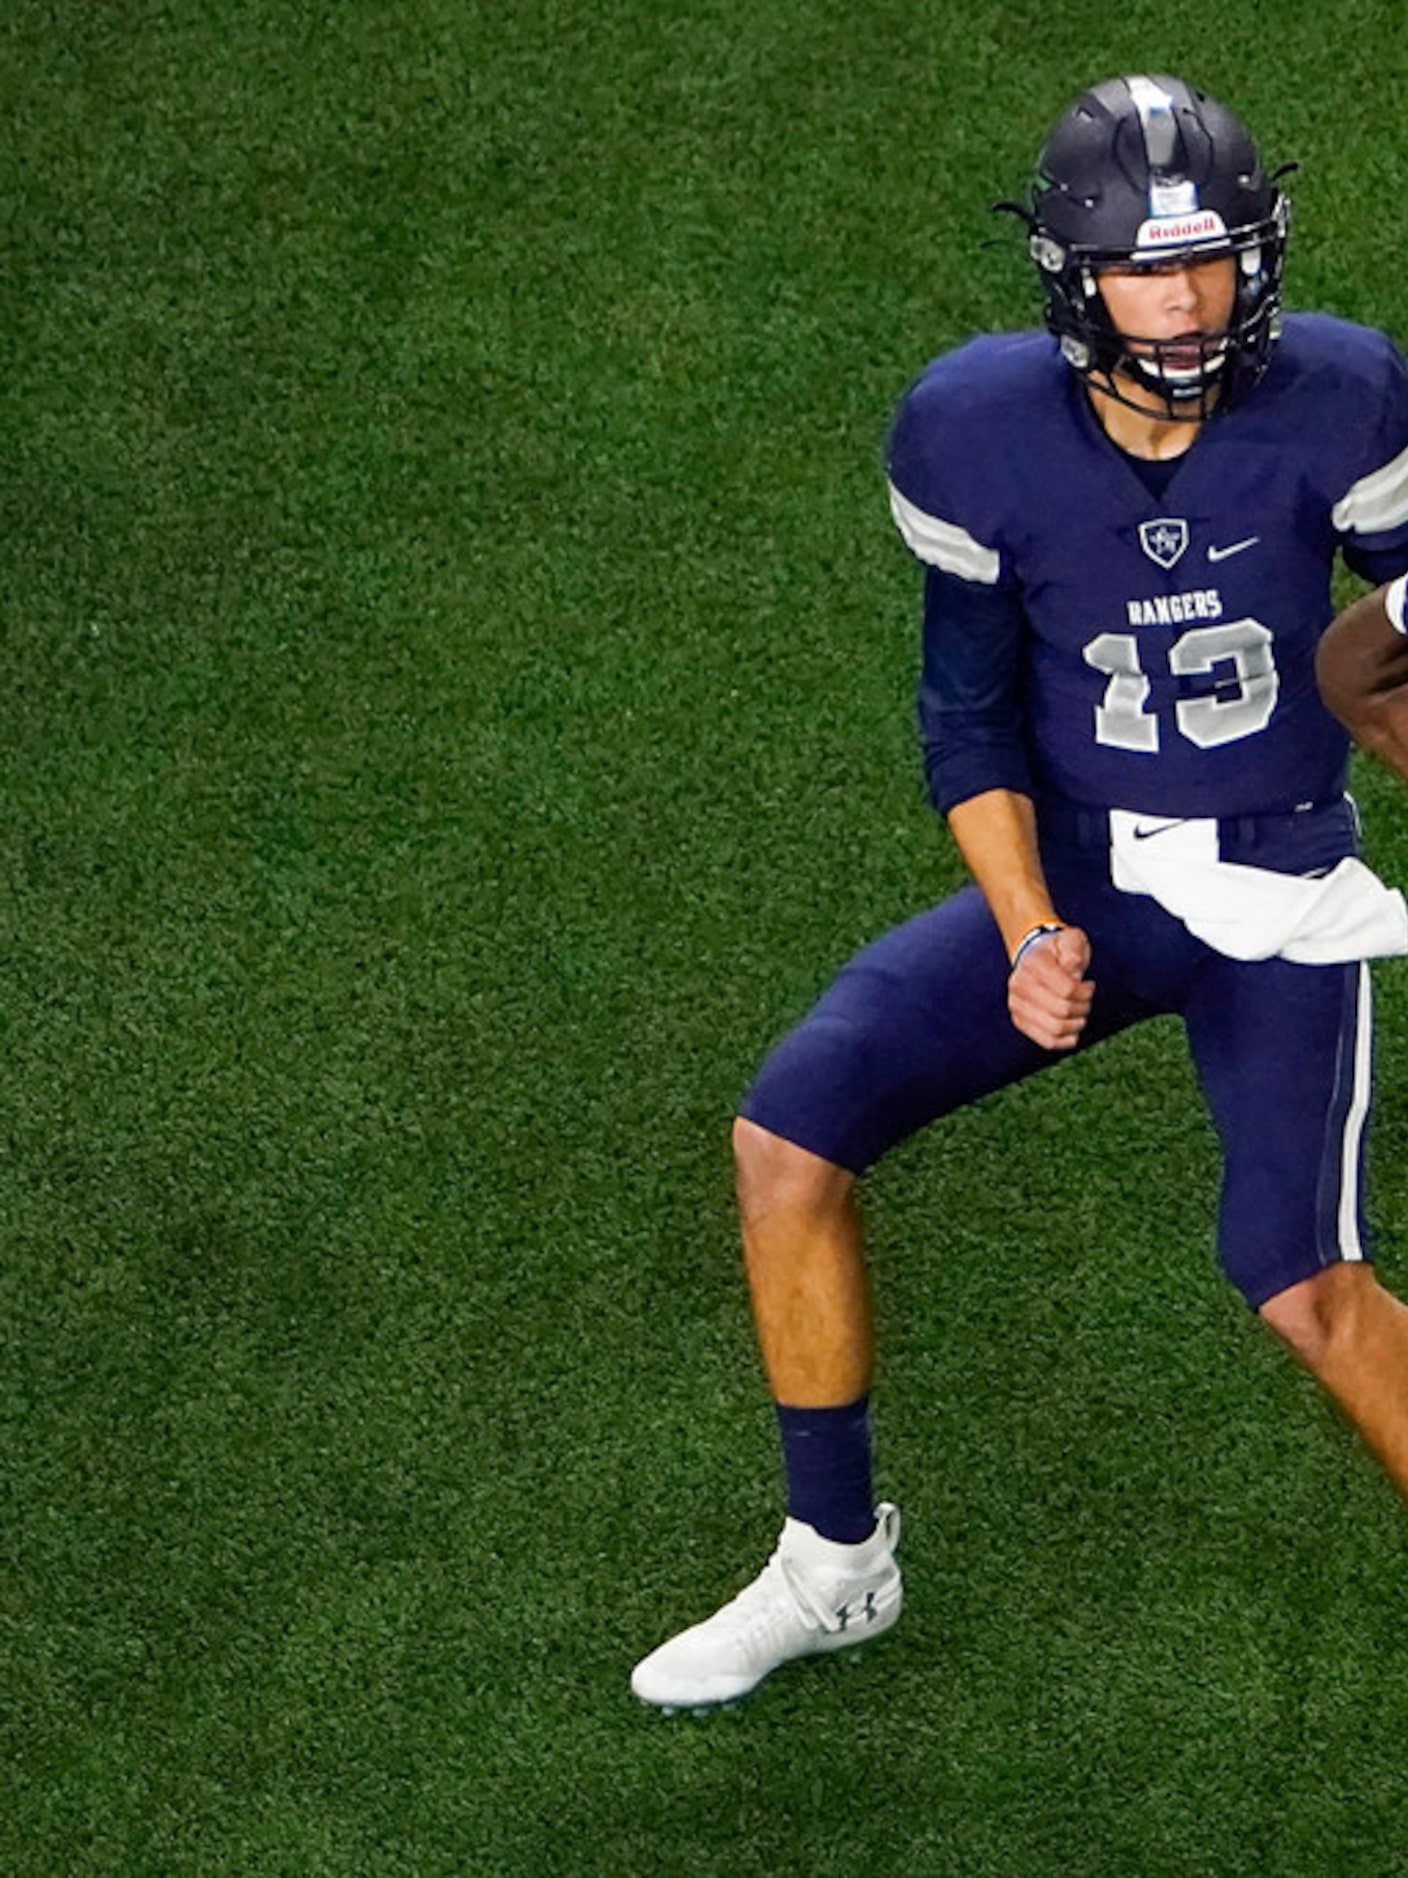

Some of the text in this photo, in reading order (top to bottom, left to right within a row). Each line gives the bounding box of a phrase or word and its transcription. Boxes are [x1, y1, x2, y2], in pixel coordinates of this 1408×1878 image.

[1149, 217, 1215, 239] Riddell
[1126, 589, 1223, 625] RANGERS
[1082, 617, 1280, 752] 13
